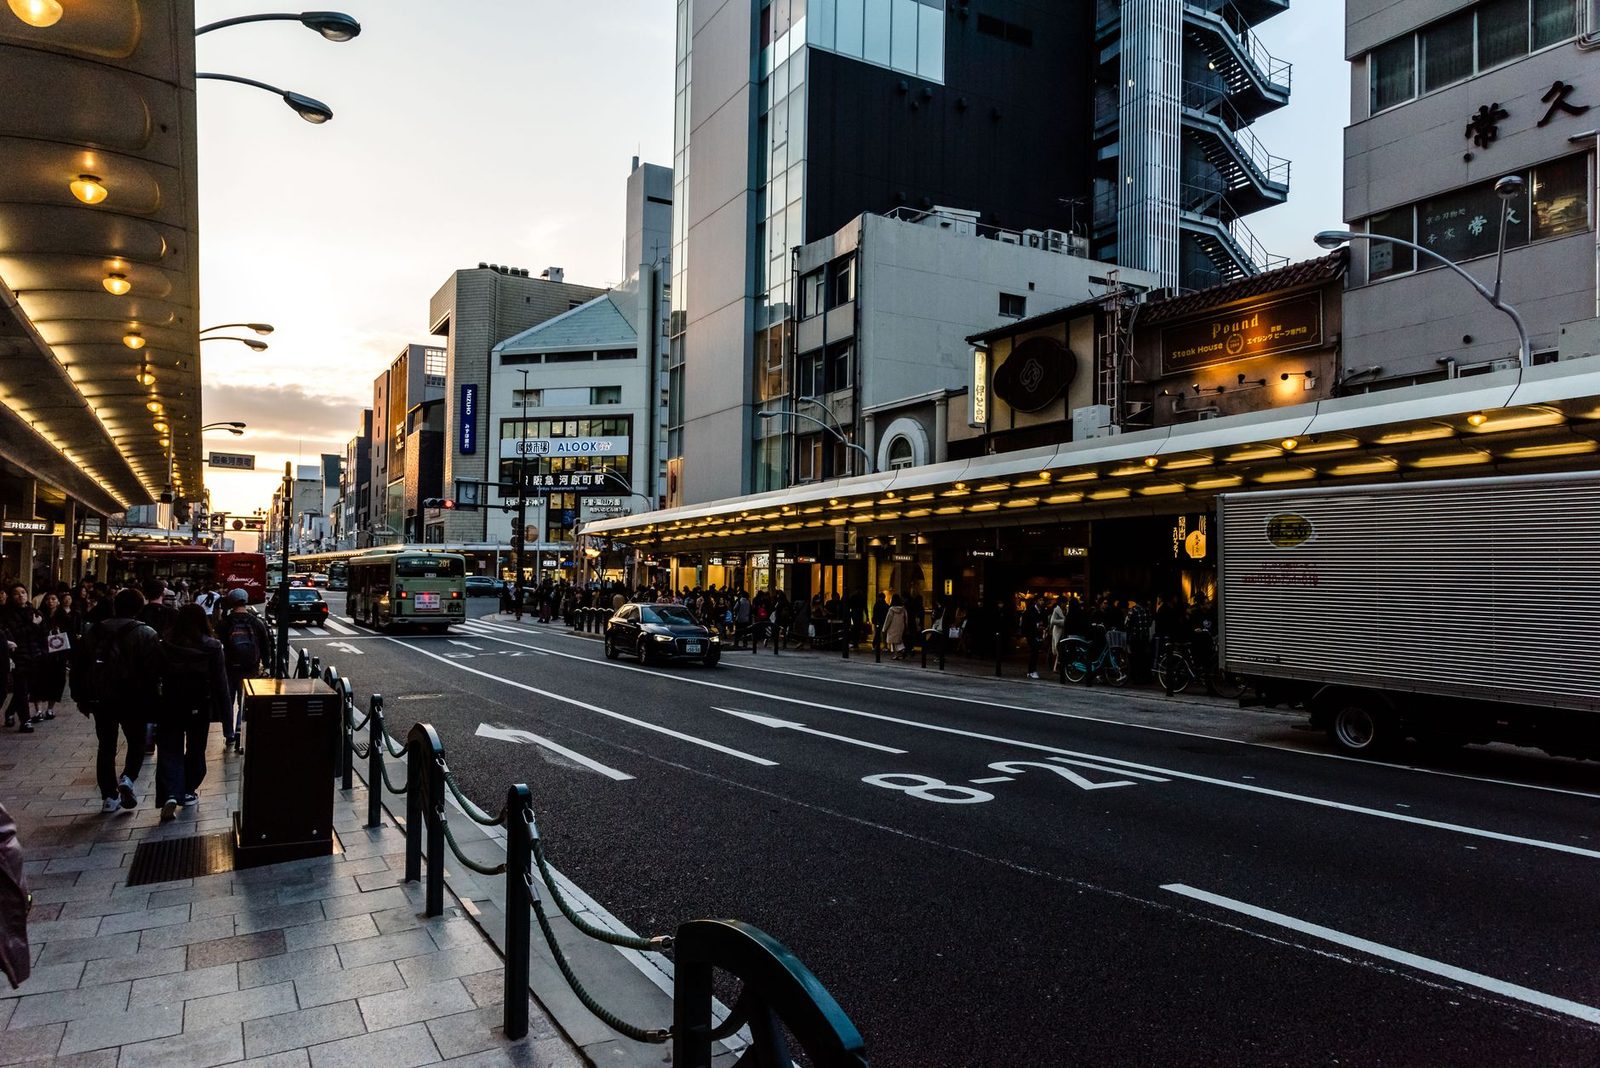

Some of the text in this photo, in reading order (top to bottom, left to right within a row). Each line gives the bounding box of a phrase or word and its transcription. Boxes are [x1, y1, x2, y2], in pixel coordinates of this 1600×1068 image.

[1464, 80, 1590, 149] 常久
[1212, 313, 1259, 339] Pound
[1171, 348, 1196, 359] Steak
[1197, 342, 1223, 354] House
[557, 442, 597, 452] ALOOK
[532, 474, 605, 486] 阪急 河原町駅
[4, 521, 46, 530] 三井住友銀行
[439, 559, 450, 567] 201
